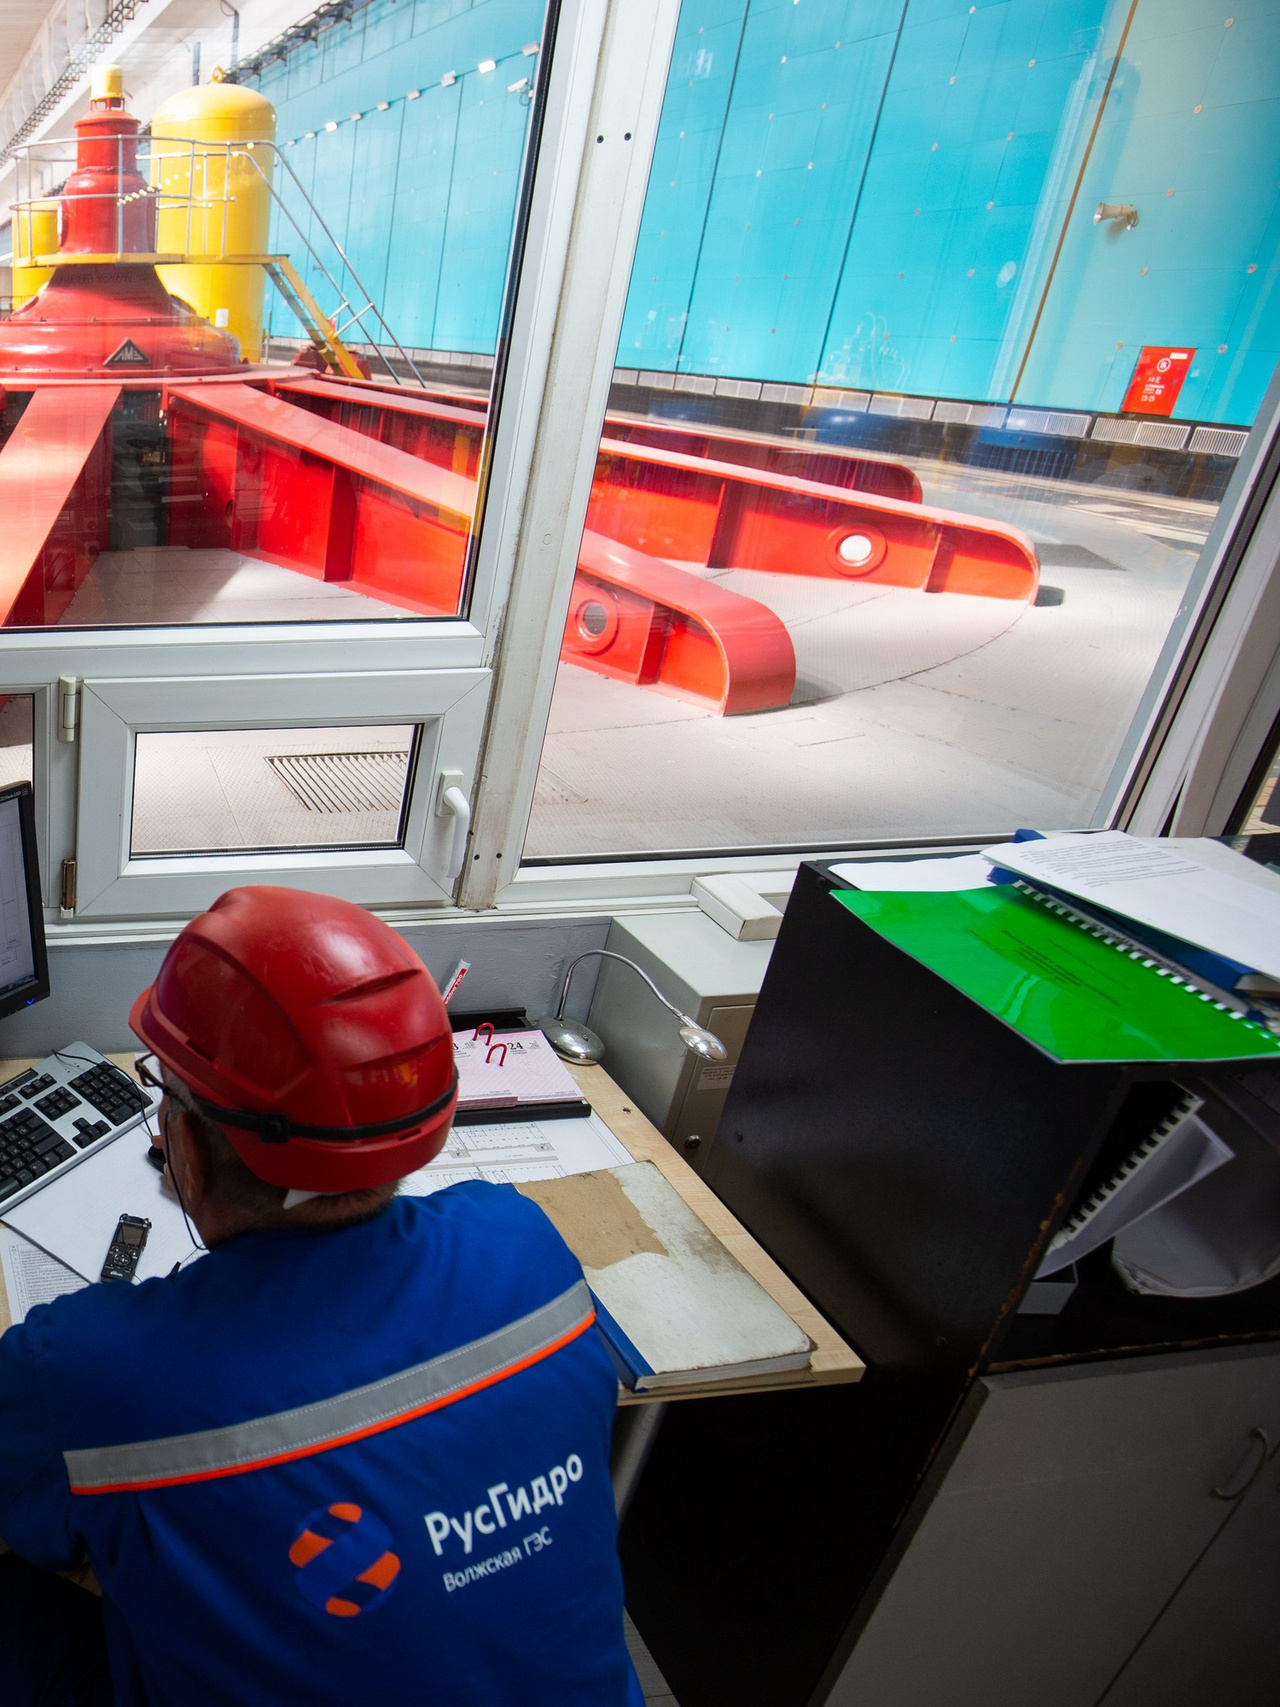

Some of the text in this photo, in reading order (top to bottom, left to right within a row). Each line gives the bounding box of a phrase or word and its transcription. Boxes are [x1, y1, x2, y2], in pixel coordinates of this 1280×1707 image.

[507, 1042, 524, 1051] 24
[424, 1454, 584, 1556] РусГидро
[442, 1526, 553, 1593] Волжская ГЭС
